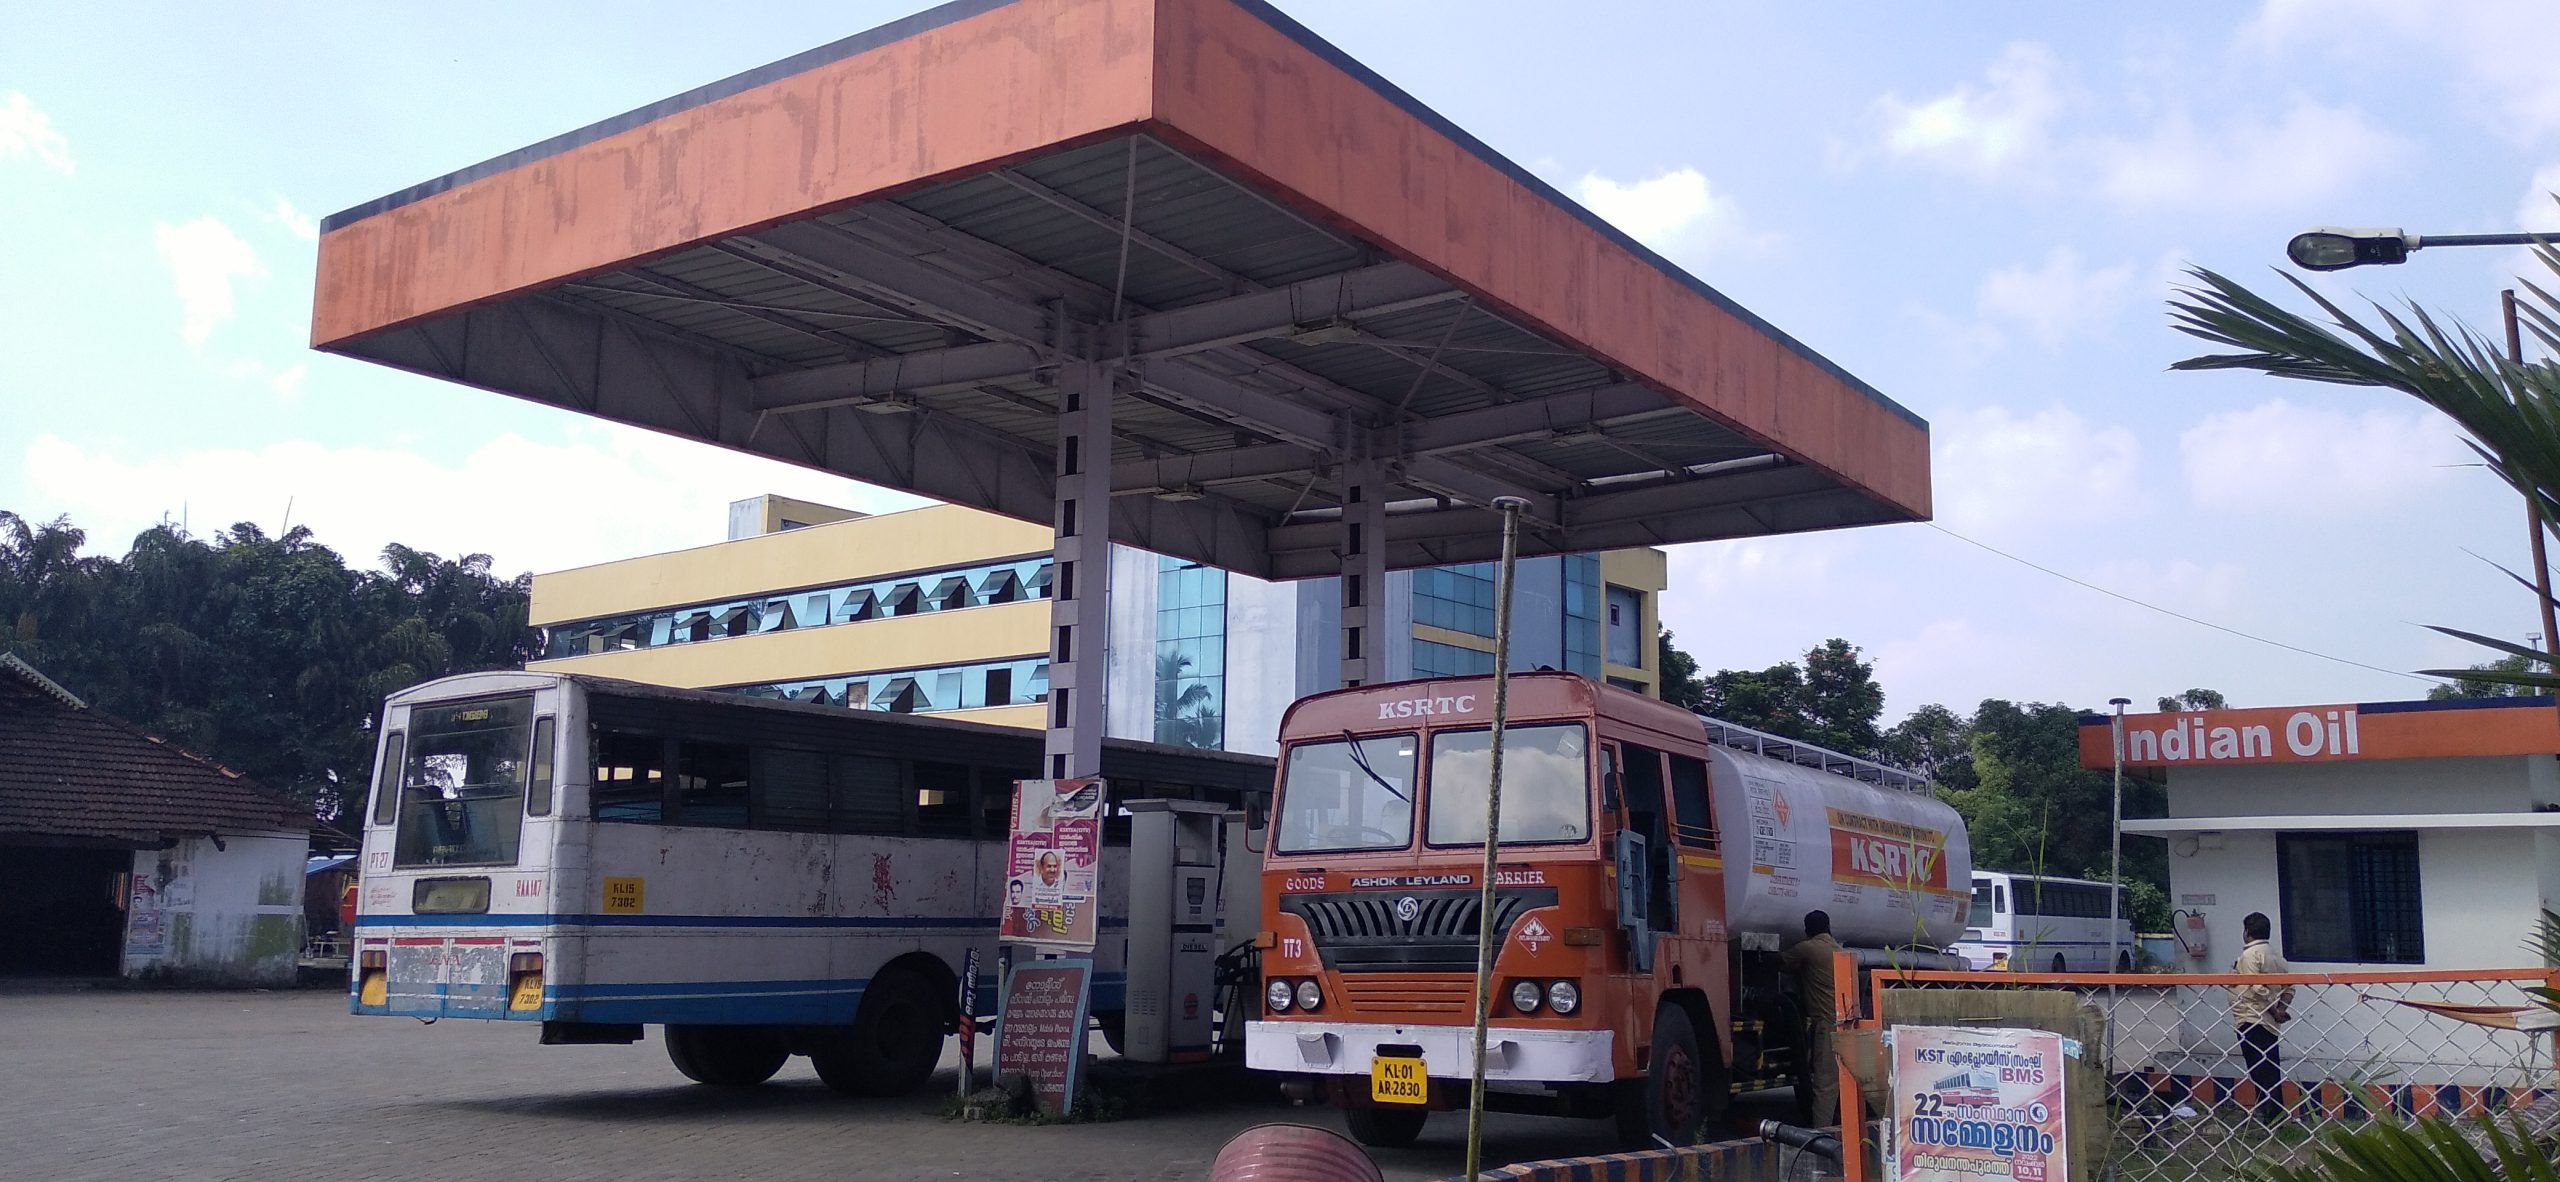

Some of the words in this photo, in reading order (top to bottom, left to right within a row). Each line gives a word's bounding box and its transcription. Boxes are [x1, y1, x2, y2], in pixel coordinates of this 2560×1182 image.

[1378, 694, 1476, 720] KSRTC
[2286, 710, 2359, 757] Oil
[1286, 876, 1325, 890] GOODS
[1352, 877, 1398, 887] ASHOK
[1406, 874, 1471, 886] LEYLAND
[1495, 871, 1545, 885] ARRIER
[1182, 943, 1205, 951] DIESEL
[1530, 941, 1537, 952] 3
[1914, 1047, 1946, 1063] KST
[1947, 1050, 2011, 1069] എംപ്ലോയീസ്
[2000, 1066, 2044, 1084] BMS
[1957, 1104, 2026, 1123] സംസ്ഥാന
[1911, 1116, 2054, 1156] സമ്മേളനം
[1913, 1153, 2011, 1176] തിരുവനന്തപുരത്ത്
